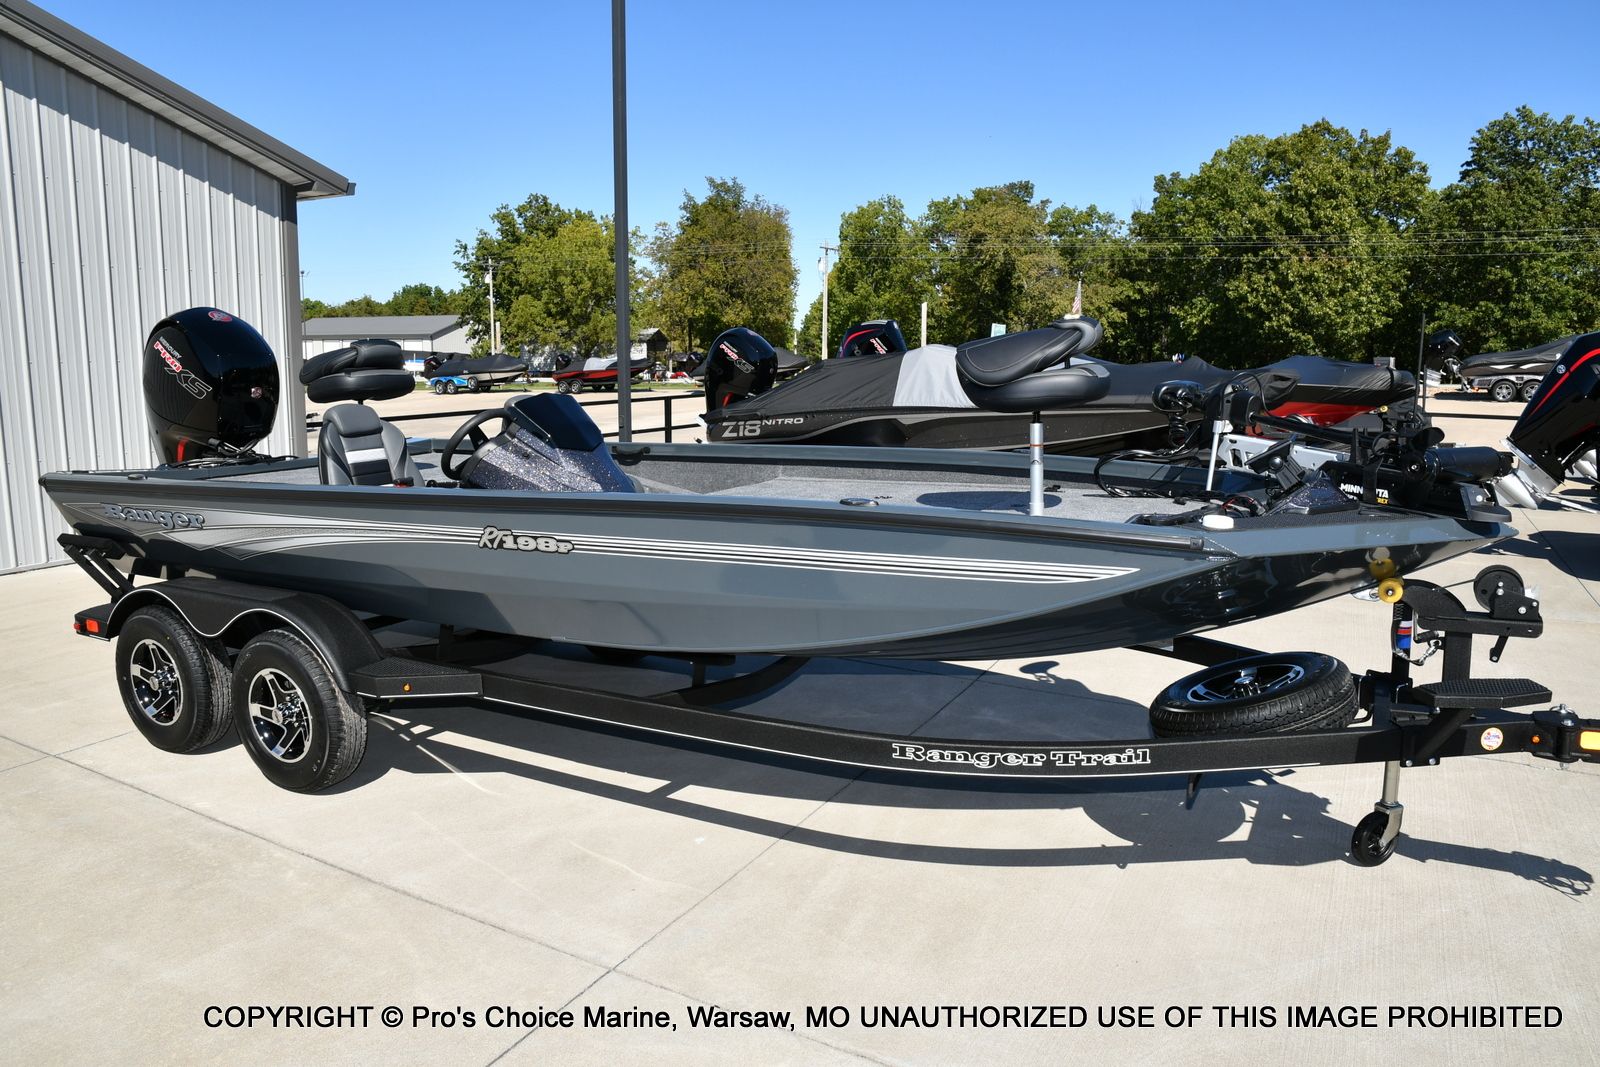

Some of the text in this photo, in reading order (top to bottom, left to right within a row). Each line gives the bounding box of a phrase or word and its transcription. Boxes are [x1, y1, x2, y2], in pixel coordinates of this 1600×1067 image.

[153, 340, 213, 400] PRO XS
[721, 417, 804, 438] Z18 NITRO
[1340, 482, 1364, 495] MINN
[101, 502, 205, 530] Ranger
[892, 743, 1151, 768] Ranger Trail
